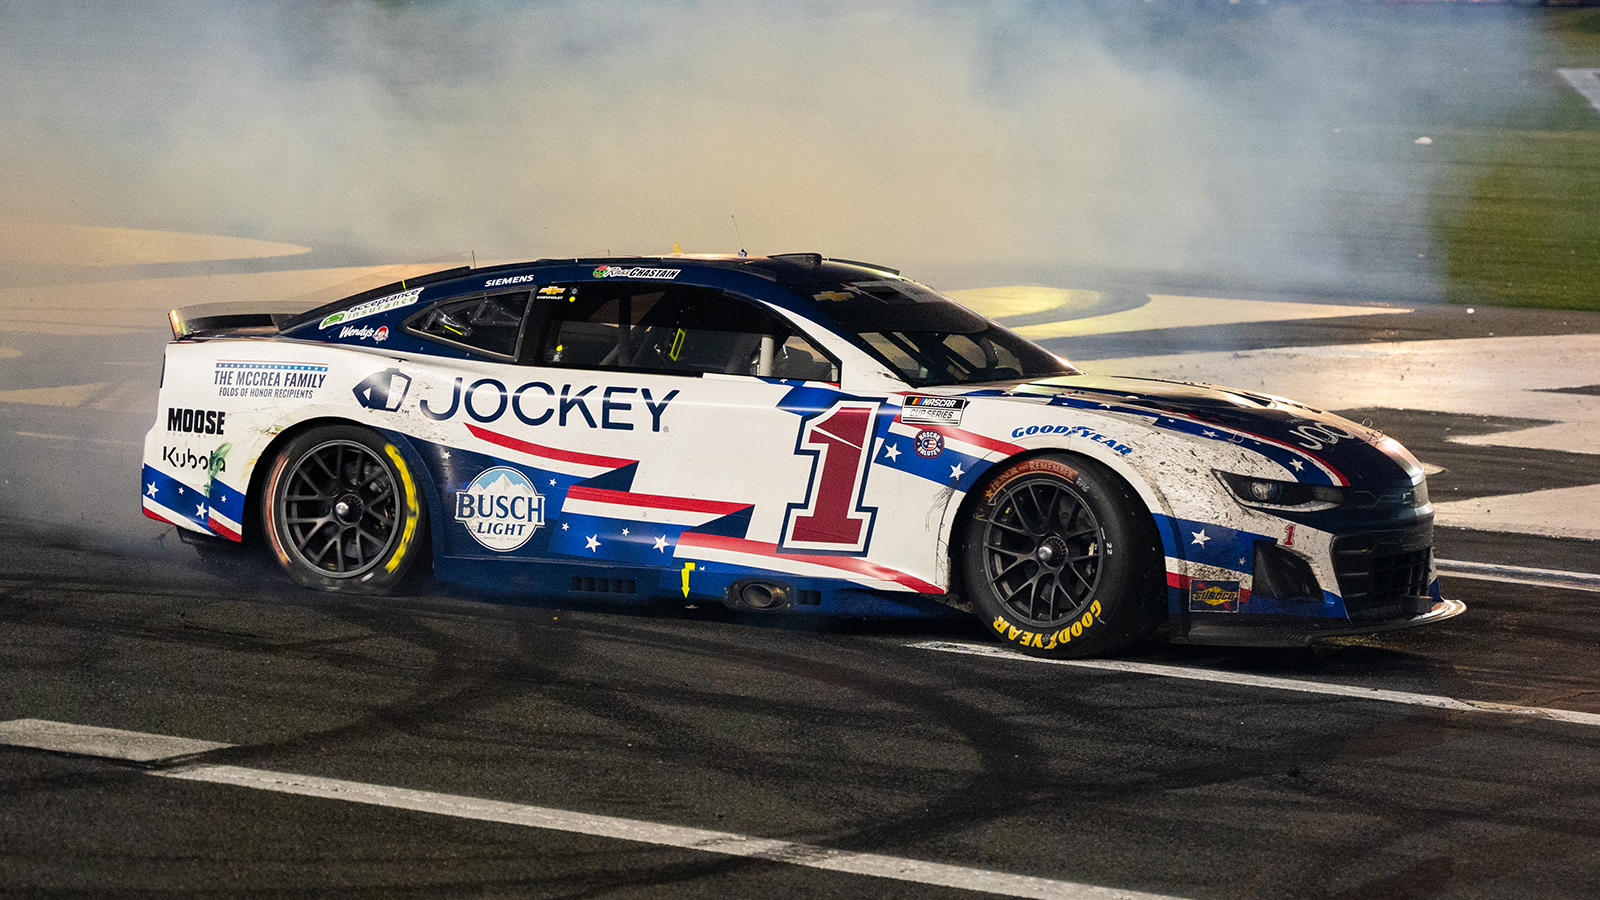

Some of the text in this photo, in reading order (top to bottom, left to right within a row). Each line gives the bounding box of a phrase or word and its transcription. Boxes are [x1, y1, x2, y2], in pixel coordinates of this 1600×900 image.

[485, 274, 534, 287] SIEMENS
[629, 268, 678, 278] CHASTAIN
[347, 296, 416, 319] insurance
[350, 289, 418, 313] acceptance
[339, 325, 374, 340] Wendy's
[214, 370, 326, 388] THE MCCREA FAMILY
[219, 387, 313, 399] FOLDS OF HONOR RECIPIENTS
[420, 377, 680, 432] JOCKEY
[922, 398, 957, 408] NASCAR
[167, 408, 226, 435] MOOSE
[910, 409, 954, 419] CUP SERIES
[1012, 425, 1132, 455] GOODYEAR
[776, 396, 889, 557] 1
[991, 467, 1020, 491] HONOR
[1029, 461, 1075, 481] REMEMBER
[457, 494, 543, 522] BUSCH
[476, 522, 526, 536] LIGHT
[1283, 523, 1296, 547] 1
[1193, 591, 1237, 601] SUNOCO
[993, 600, 1101, 649] GOODYEAR
